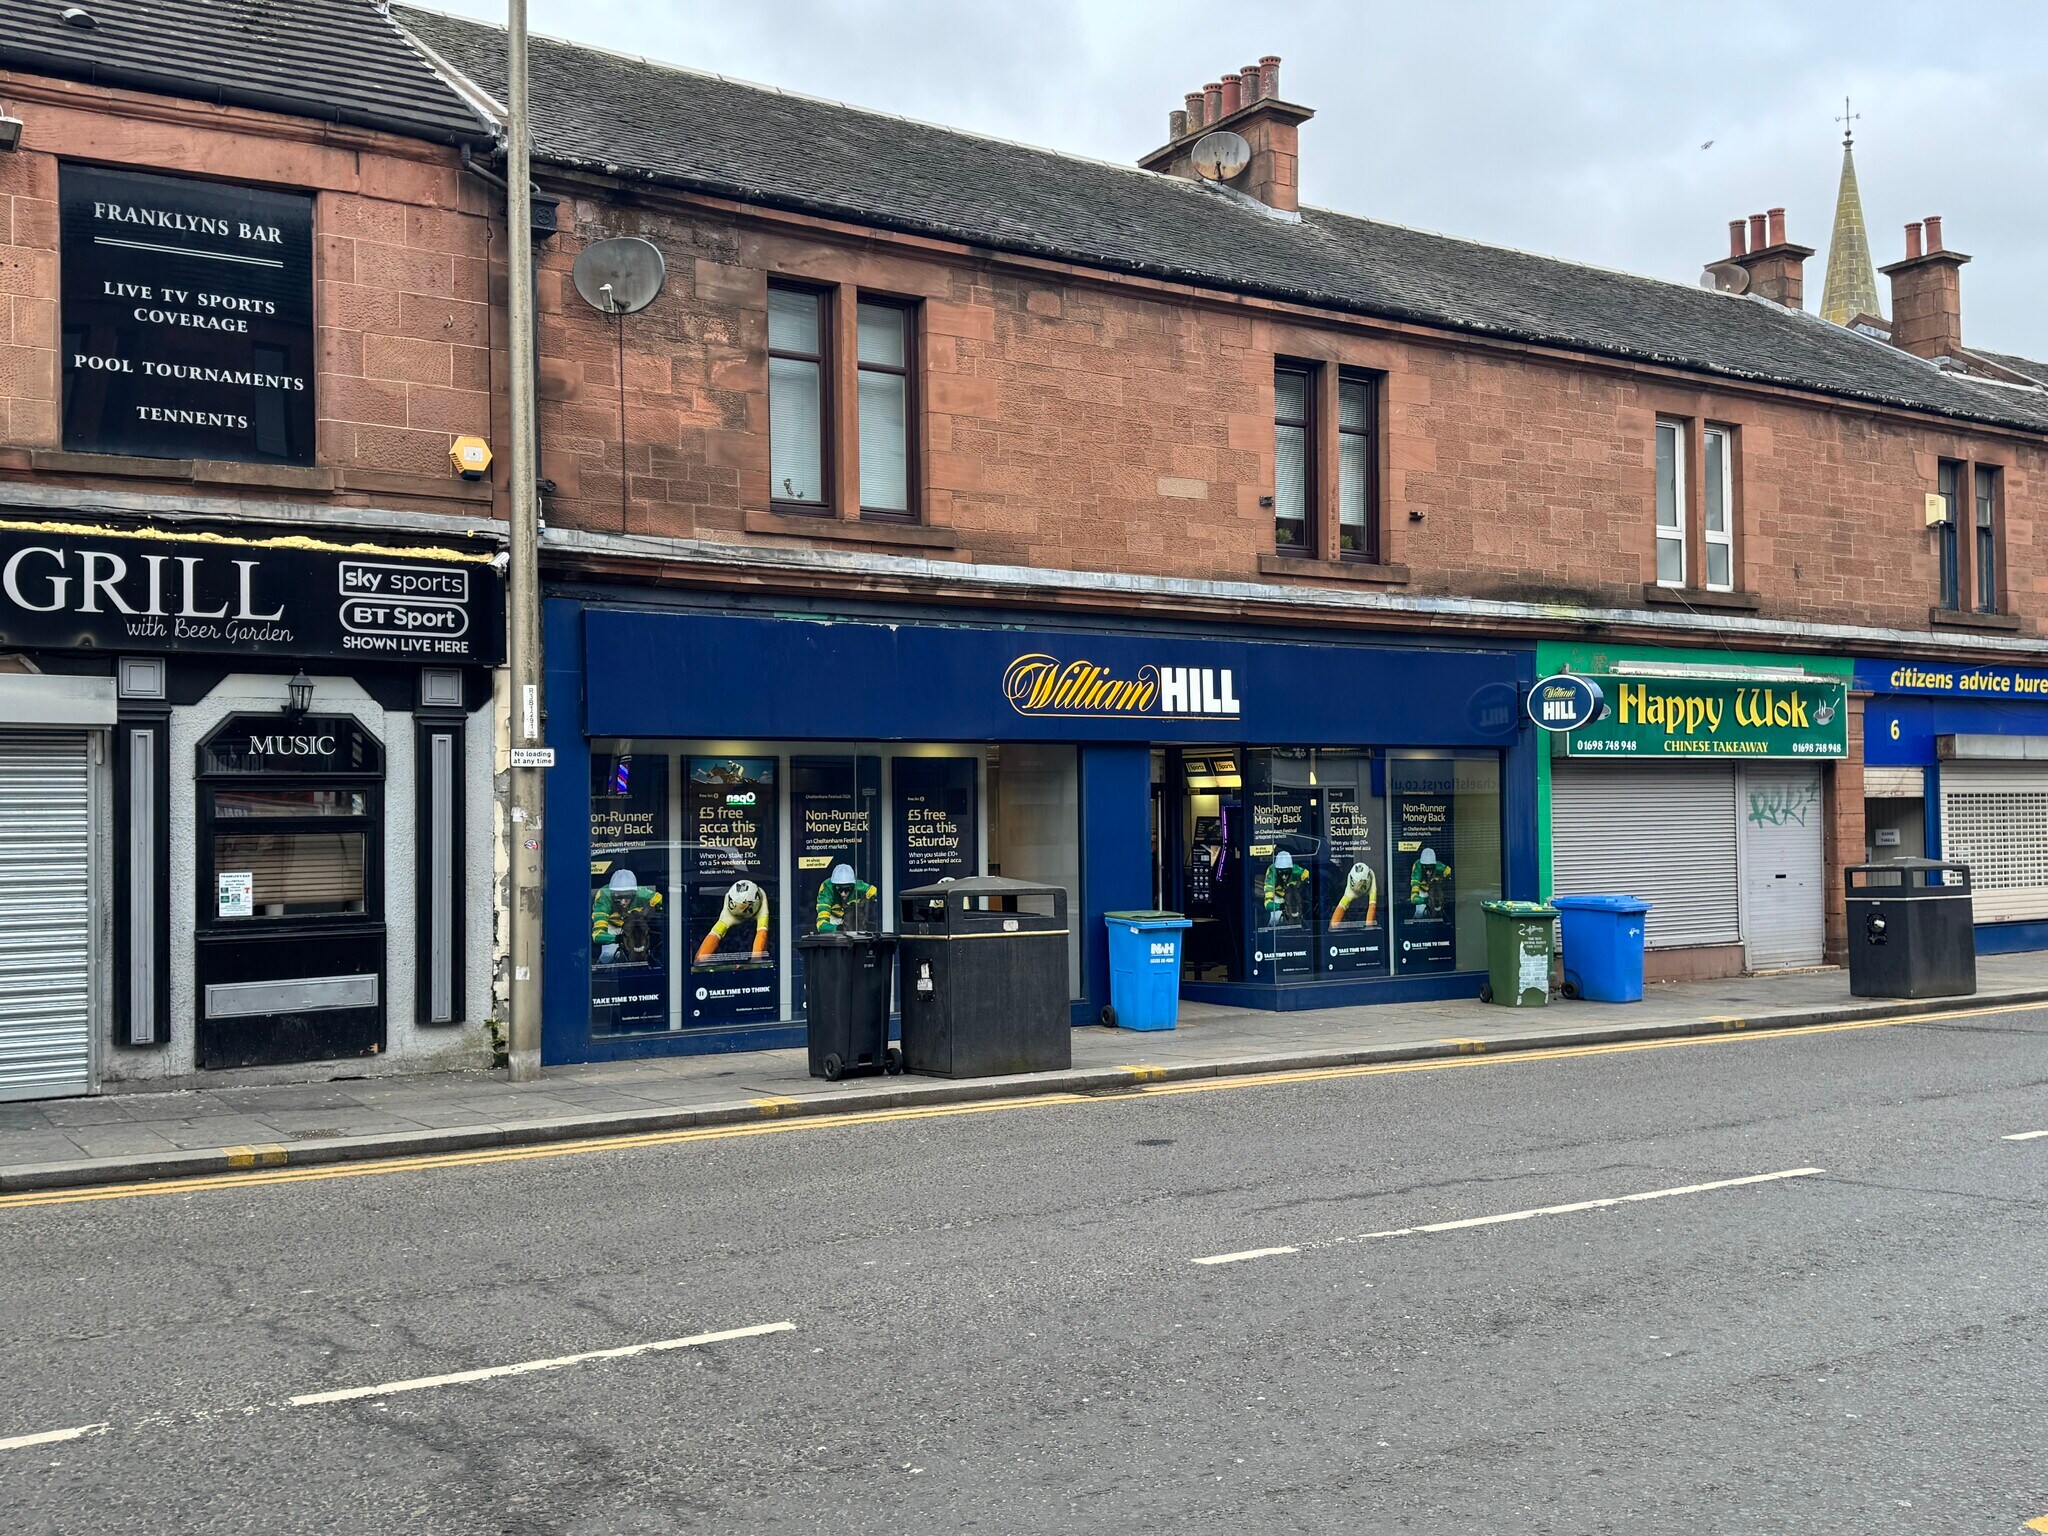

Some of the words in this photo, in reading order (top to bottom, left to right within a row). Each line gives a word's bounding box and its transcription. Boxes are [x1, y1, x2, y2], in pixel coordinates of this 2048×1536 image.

[93, 201, 229, 237] FRANKLYNS
[238, 222, 283, 244] BAR
[103, 281, 153, 300] LIVE
[161, 288, 189, 304] TV
[197, 293, 276, 316] SPORTS
[133, 307, 248, 333] COVERAGE
[73, 354, 134, 374] POOL
[142, 361, 304, 391] TOURNAMENTS
[136, 406, 248, 430] TENNENTS
[2, 547, 285, 621] GRILL
[344, 568, 382, 592] sky
[390, 573, 463, 594] sports
[353, 607, 389, 624] BT
[393, 607, 455, 629] Sport
[125, 617, 168, 637] with
[174, 618, 221, 640] Beer
[226, 619, 294, 645] Garden
[342, 635, 399, 651] SHOWN
[401, 637, 430, 652] LIVE
[433, 639, 469, 653] HERE
[1003, 653, 1160, 712] William
[1161, 667, 1240, 714] HILL
[1891, 667, 1953, 689] citizens
[1959, 670, 2010, 693] advice
[1543, 686, 1576, 699] William
[1543, 700, 1577, 720] HILL
[1619, 683, 1723, 734] Happy
[1734, 688, 1810, 728] Wok
[1890, 719, 1901, 740] 6
[249, 735, 336, 755] MUSIC
[1577, 740, 1604, 751] 01698
[1605, 740, 1620, 751] 748
[1621, 740, 1637, 751] 948
[1664, 740, 1712, 753] CHINESE
[1713, 741, 1769, 753] TAKEAWAY
[1792, 742, 1812, 753] 01698
[1813, 743, 1827, 753] 748
[1828, 743, 1841, 753] 948
[699, 807, 714, 819] £5
[717, 806, 743, 819] free
[805, 809, 869, 820] Non-Runner
[1254, 805, 1302, 814] Non-Runner
[1330, 804, 1340, 813] £5
[1342, 803, 1359, 813] free
[1403, 803, 1446, 812] Non-Runner
[591, 811, 654, 822] on-Runner
[908, 810, 921, 821] £5
[924, 809, 946, 820] free
[1254, 815, 1281, 825] Money
[1283, 814, 1302, 823] Back
[1330, 816, 1349, 824] acca
[1351, 814, 1367, 824] this
[1403, 813, 1427, 823] Money
[1428, 813, 1445, 822] Back
[591, 826, 621, 837] oney
[624, 823, 653, 834] Back
[699, 823, 729, 833] acca
[731, 821, 756, 833] this
[806, 821, 841, 834] Money
[843, 820, 869, 832] Back
[908, 825, 934, 834] acca
[936, 821, 957, 833] this
[1330, 826, 1368, 838] Saturday
[699, 834, 757, 849] Saturday
[908, 835, 959, 848] Saturday
